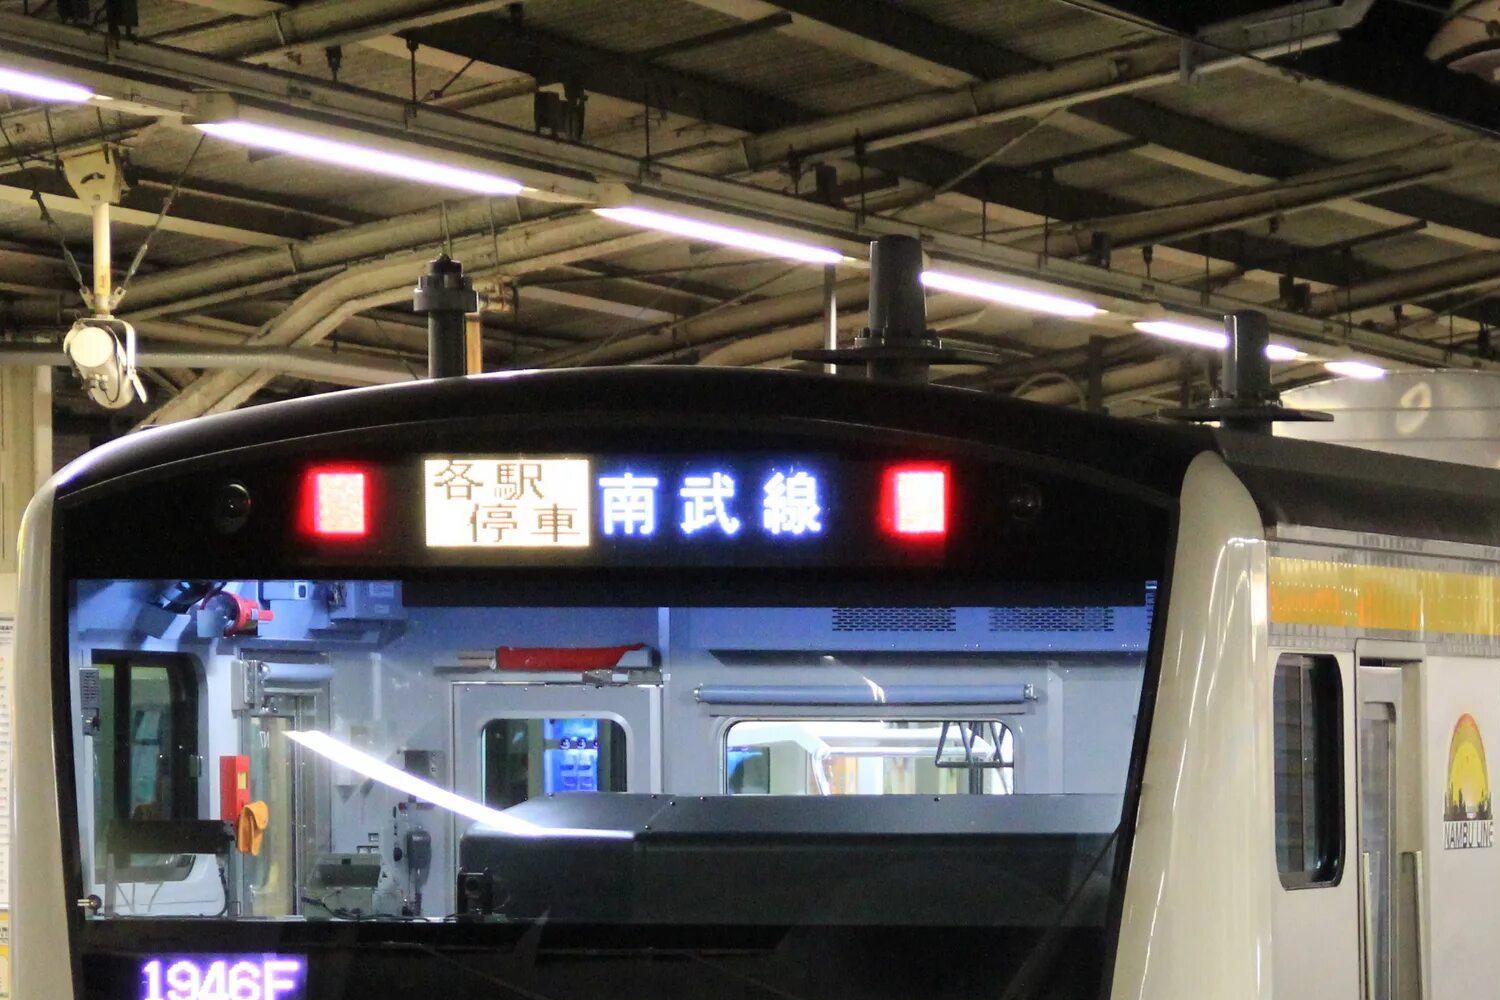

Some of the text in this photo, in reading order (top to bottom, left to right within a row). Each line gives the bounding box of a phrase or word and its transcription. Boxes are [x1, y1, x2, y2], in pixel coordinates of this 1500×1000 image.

[434, 462, 545, 501] 各駅
[467, 503, 581, 544] 停車
[598, 471, 823, 537] 南武線
[1444, 821, 1493, 849] NAMBU LINE
